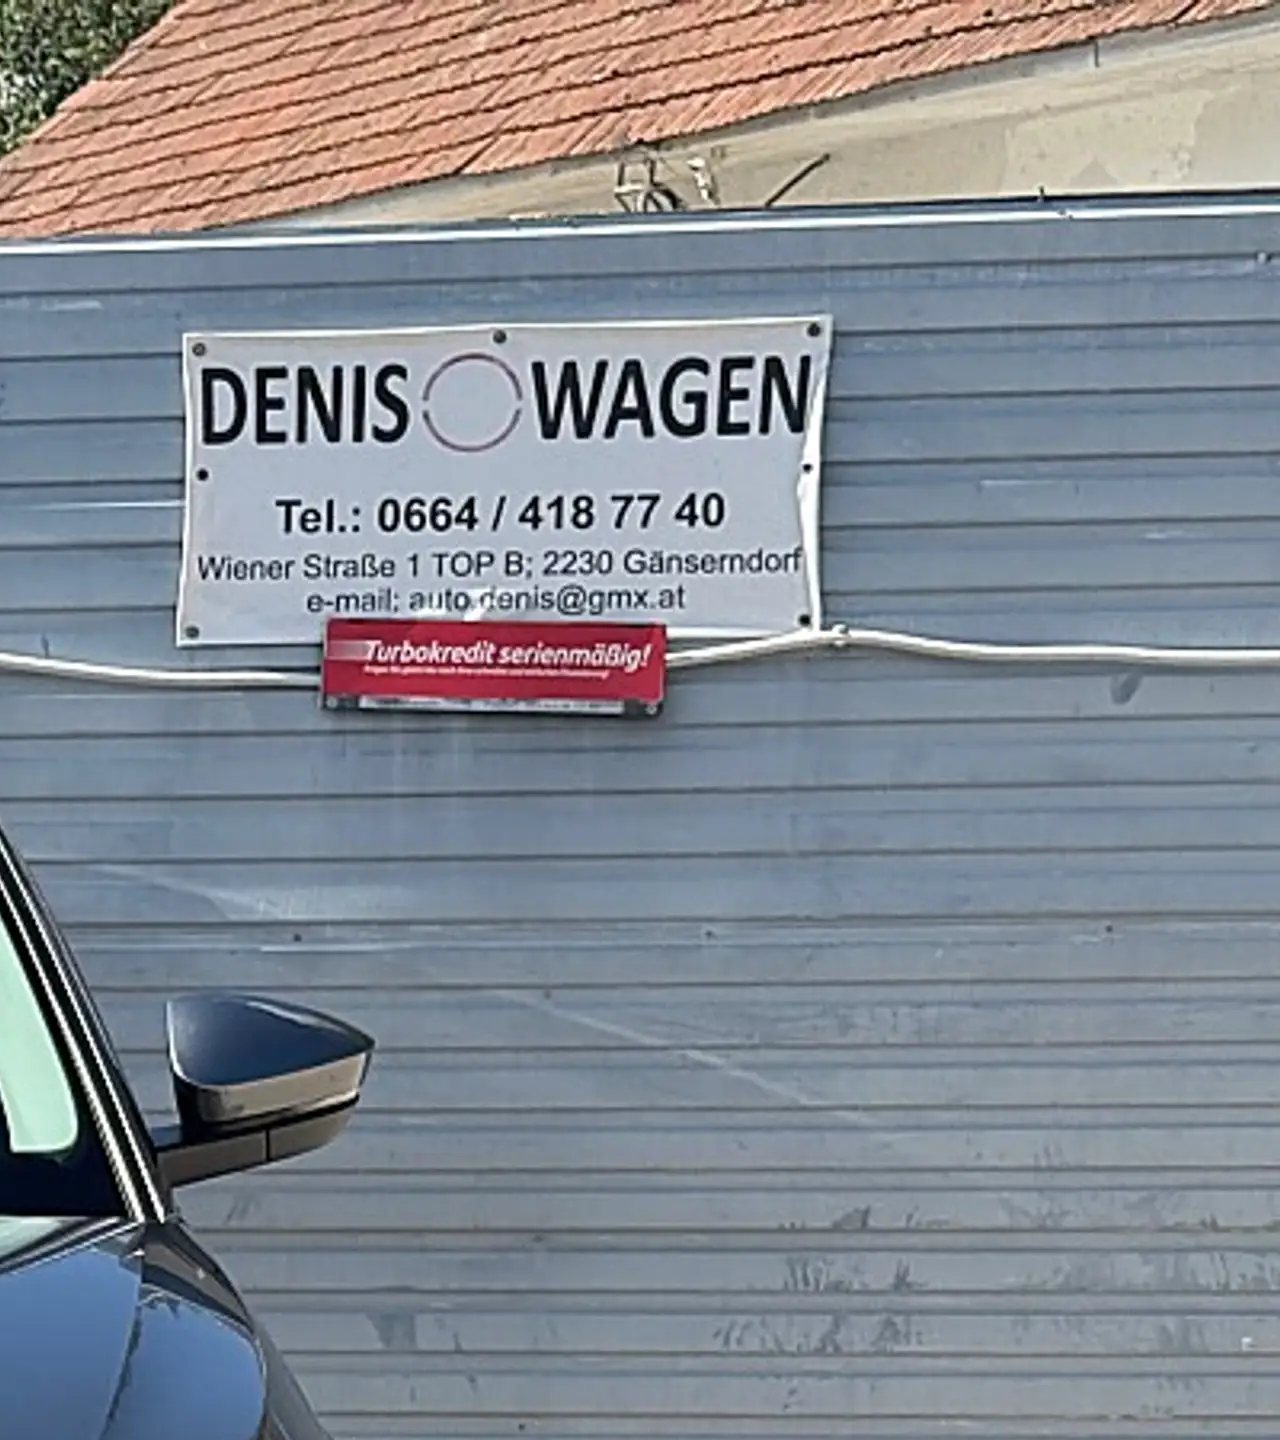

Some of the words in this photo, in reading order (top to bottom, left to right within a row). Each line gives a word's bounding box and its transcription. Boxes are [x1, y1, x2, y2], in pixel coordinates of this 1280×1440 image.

[200, 364, 409, 446] DENIS
[532, 355, 812, 439] WAGEN
[276, 499, 361, 534] Tel.:
[377, 496, 479, 533] 0664
[491, 496, 507, 532] /
[518, 494, 595, 531] 418
[611, 493, 661, 529] 77
[675, 492, 726, 529] 40
[197, 555, 295, 581] Wiener
[302, 553, 396, 579] Straße
[407, 553, 419, 577] 1
[432, 551, 496, 578] TOP
[503, 551, 534, 580] B;
[541, 550, 613, 577] 2230
[622, 547, 803, 575] Gänserndorf
[408, 584, 686, 616] auto.denis@gmx.at
[365, 639, 496, 666] Turbokredit
[498, 640, 653, 673] serienmäßig!
